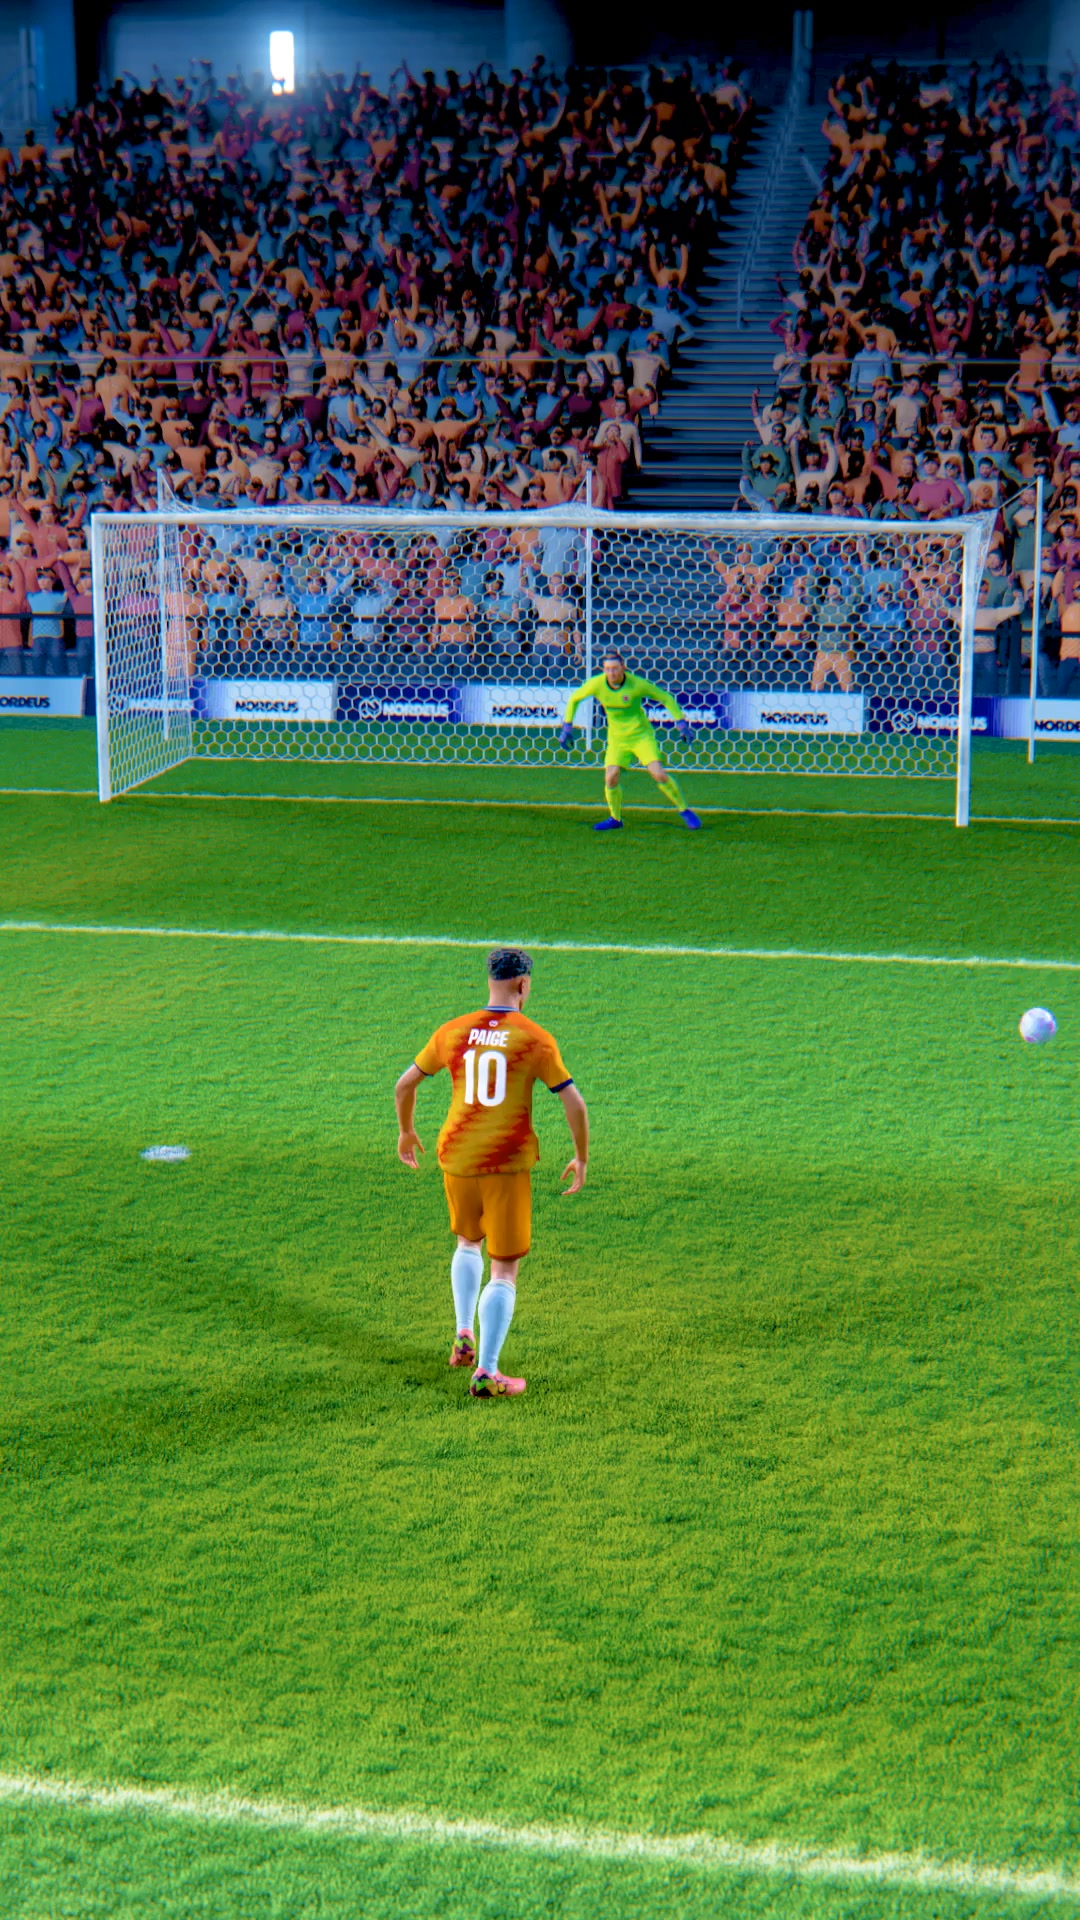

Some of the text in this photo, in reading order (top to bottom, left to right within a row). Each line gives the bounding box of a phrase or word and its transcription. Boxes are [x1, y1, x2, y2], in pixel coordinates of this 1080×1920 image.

[0, 697, 50, 708] ORDEUS
[235, 700, 299, 713] NORDEUS
[383, 702, 449, 717] NORDEUS
[492, 706, 558, 719] NORDEUS
[648, 708, 716, 723] NOEUS
[760, 712, 828, 726] NORDEUS
[917, 715, 988, 731] NORDUS
[1034, 719, 1080, 732] NORDE
[468, 1028, 510, 1047] PAIGE
[463, 1048, 507, 1107] 10
